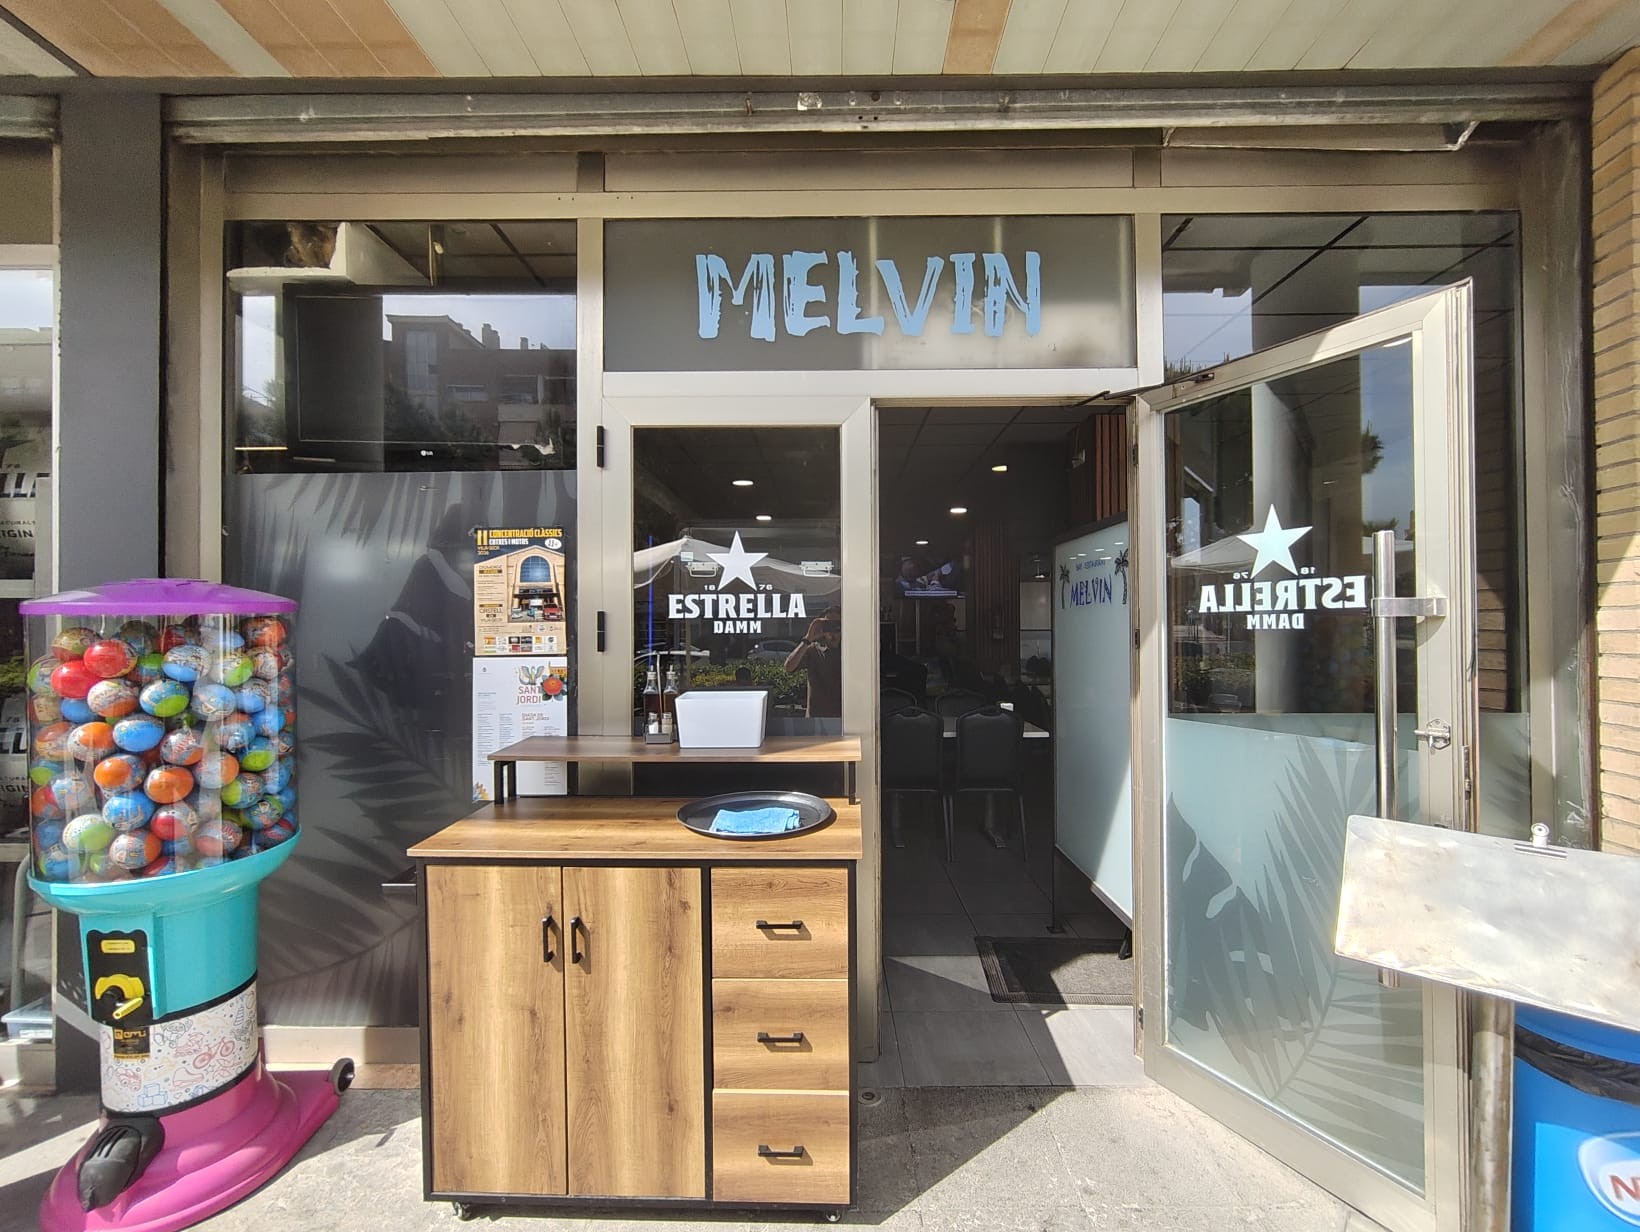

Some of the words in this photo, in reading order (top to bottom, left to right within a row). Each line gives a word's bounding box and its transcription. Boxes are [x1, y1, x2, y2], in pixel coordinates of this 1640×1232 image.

[695, 250, 1041, 342] MELVIN
[534, 528, 562, 538] CLÀSSICS
[1070, 574, 1112, 608] MELVIN
[668, 593, 807, 619] ESTRELLA
[713, 620, 761, 634] DAMM
[518, 686, 543, 694] SANT
[515, 695, 542, 705] JORDI
